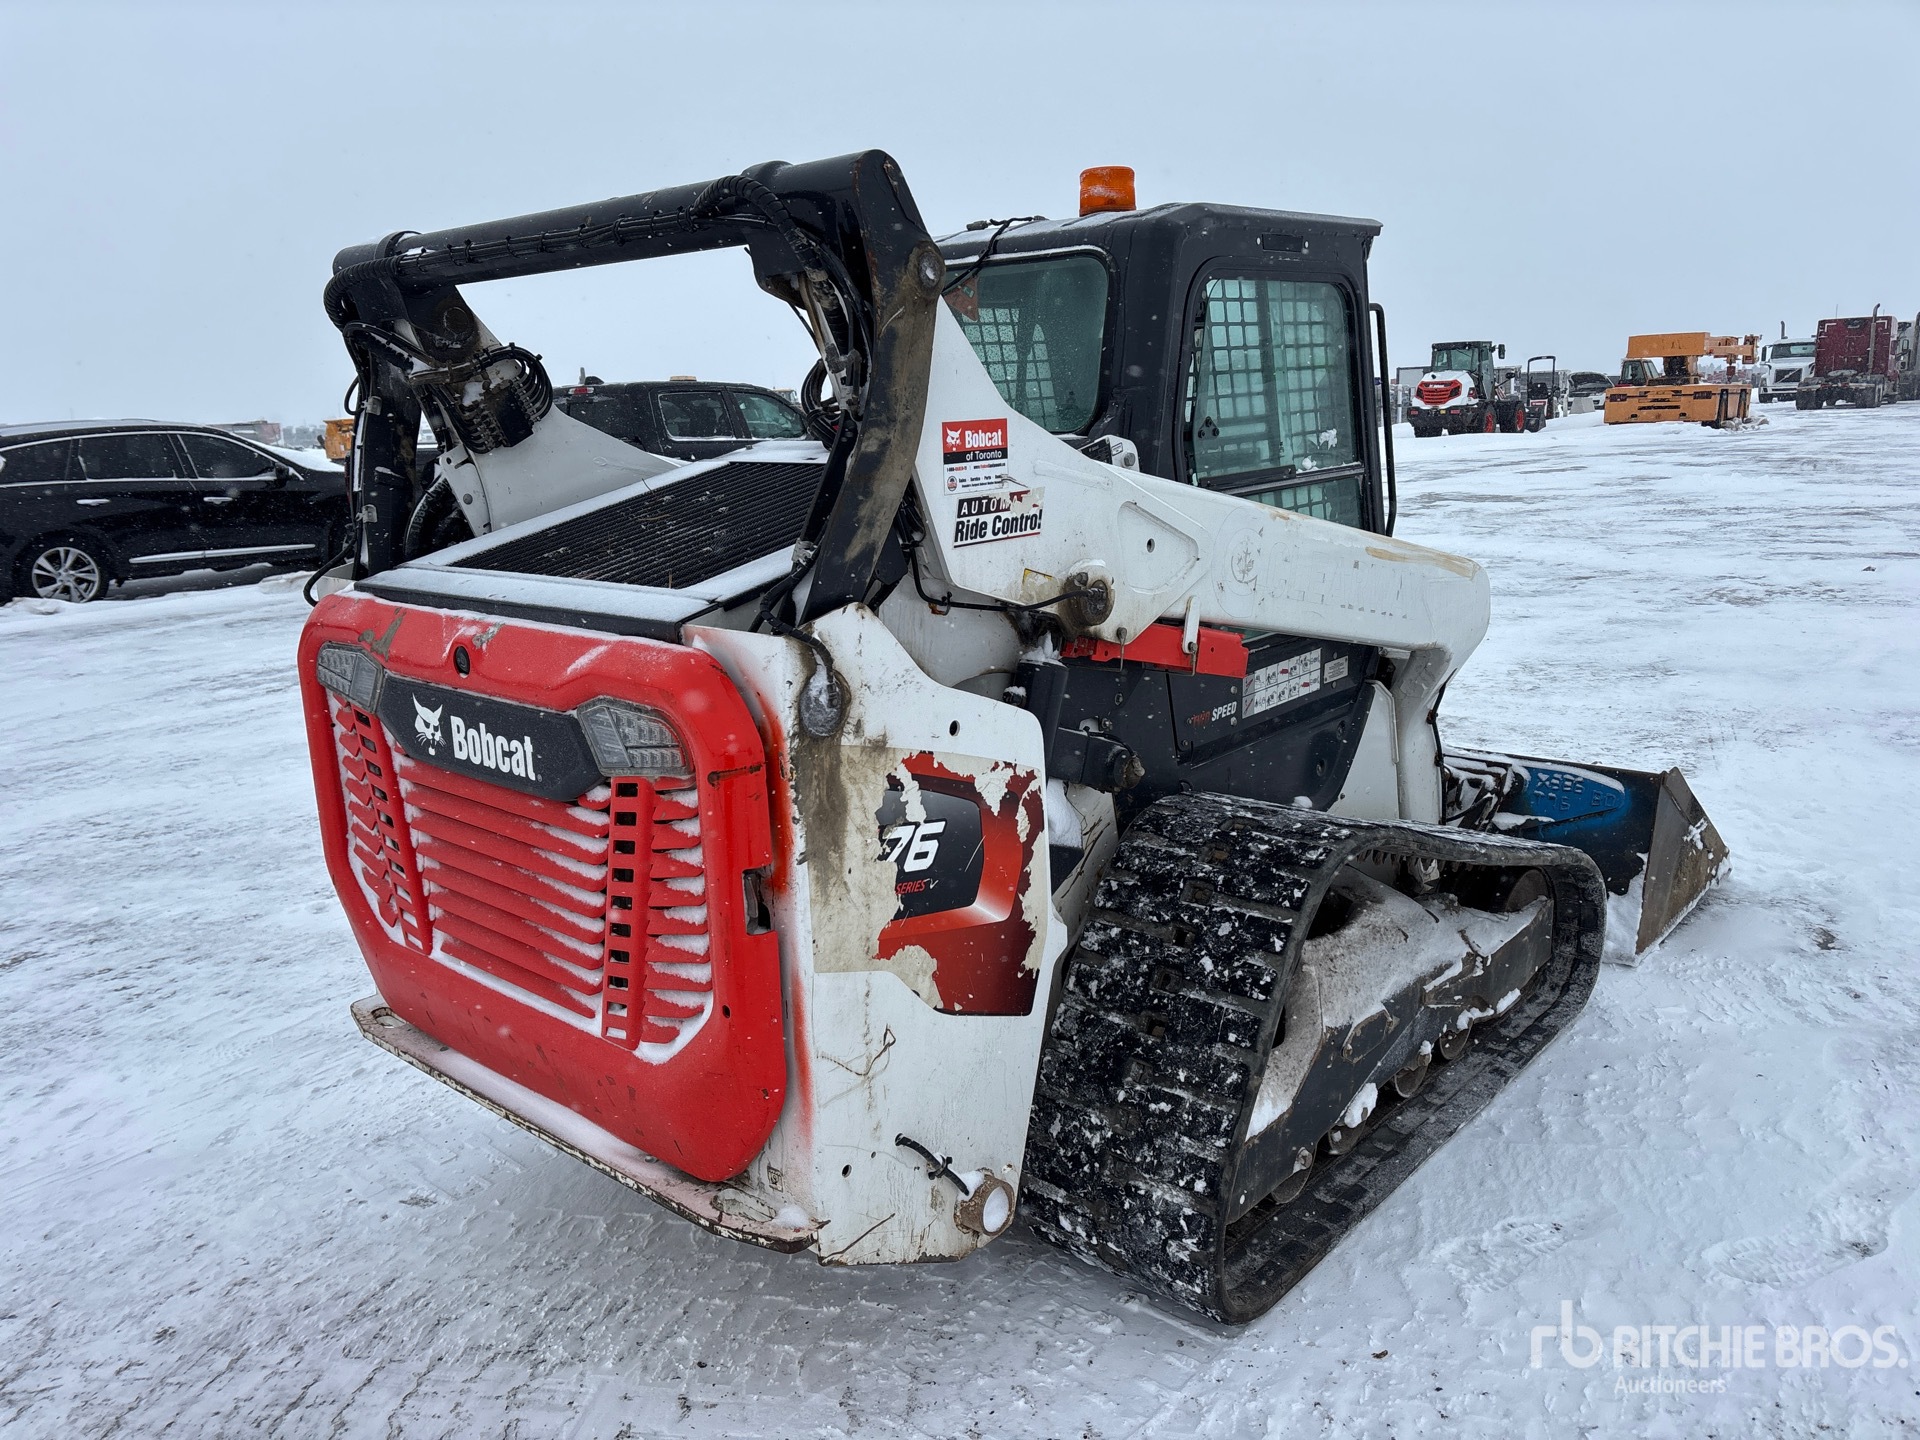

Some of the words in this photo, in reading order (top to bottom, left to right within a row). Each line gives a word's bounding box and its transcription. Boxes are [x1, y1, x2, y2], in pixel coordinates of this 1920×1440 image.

[965, 429, 1002, 449] Bobcat
[966, 452, 974, 461] of
[976, 450, 1003, 461] Toronto
[954, 518, 988, 543] Ride
[1211, 701, 1238, 722] SPEED
[450, 715, 537, 782] Bobcat
[895, 880, 926, 895] SERIES
